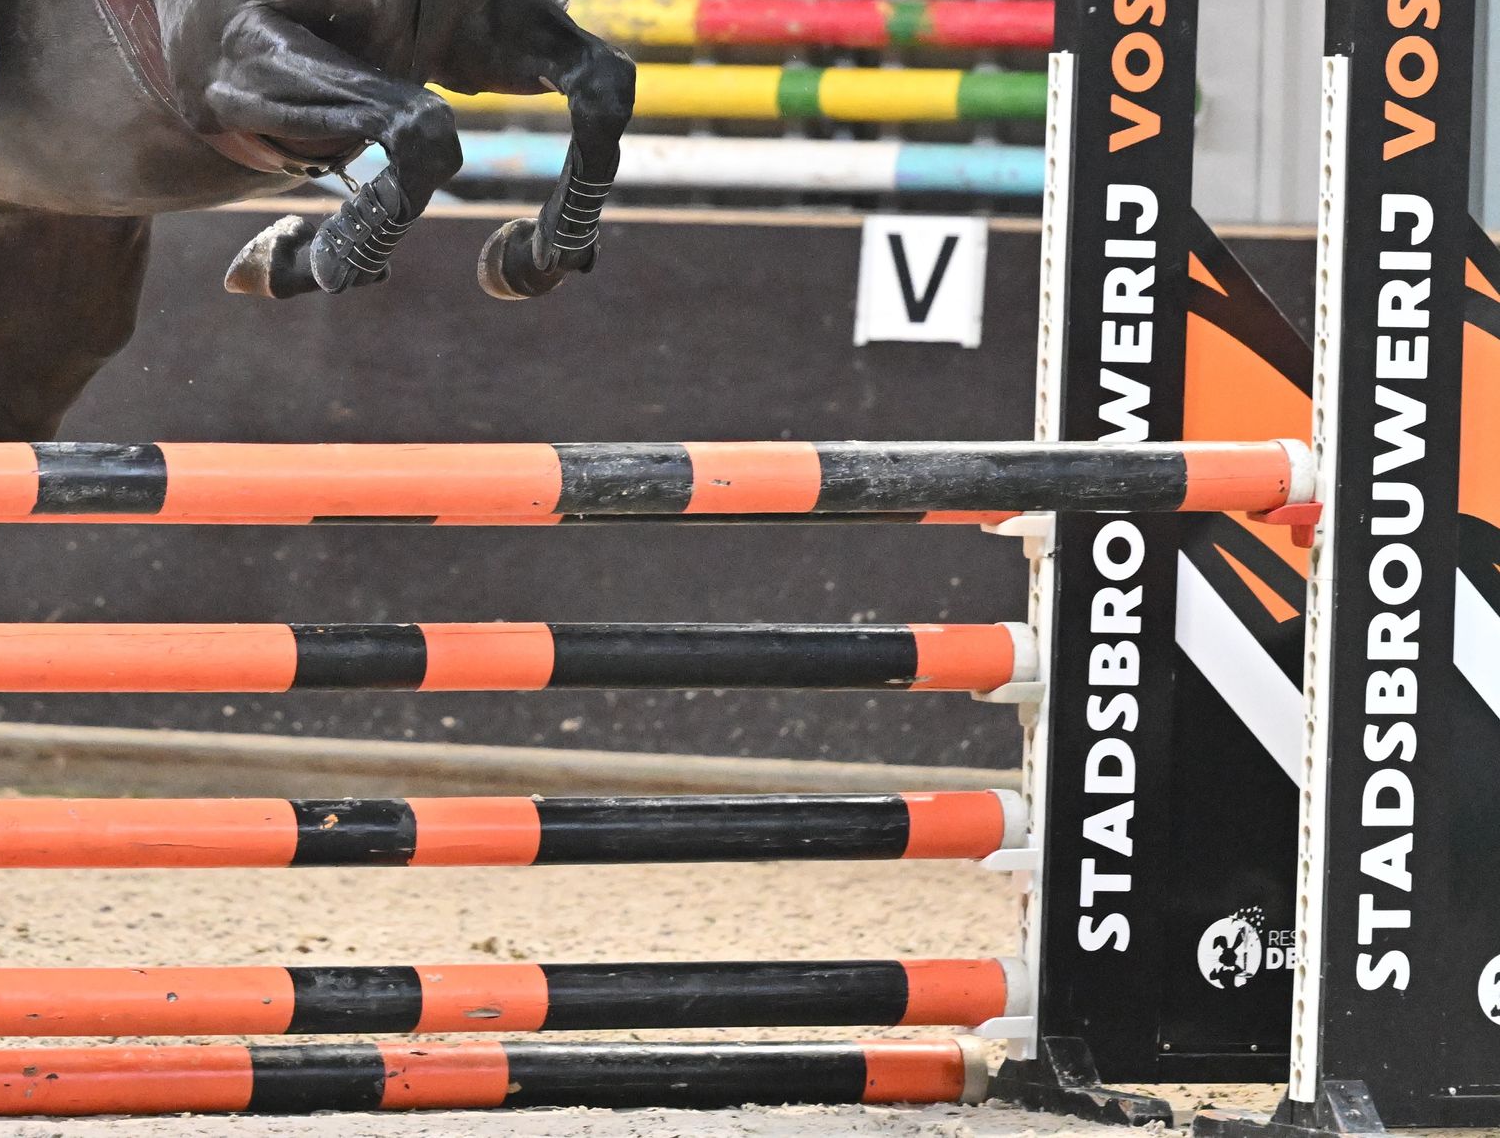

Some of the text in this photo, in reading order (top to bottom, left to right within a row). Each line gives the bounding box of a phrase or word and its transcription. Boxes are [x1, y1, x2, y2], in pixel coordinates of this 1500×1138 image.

[888, 234, 960, 324] V
[1078, 184, 1159, 953] STADSBROWERIJ
[1356, 193, 1434, 991] STADSBROUWERIJ
